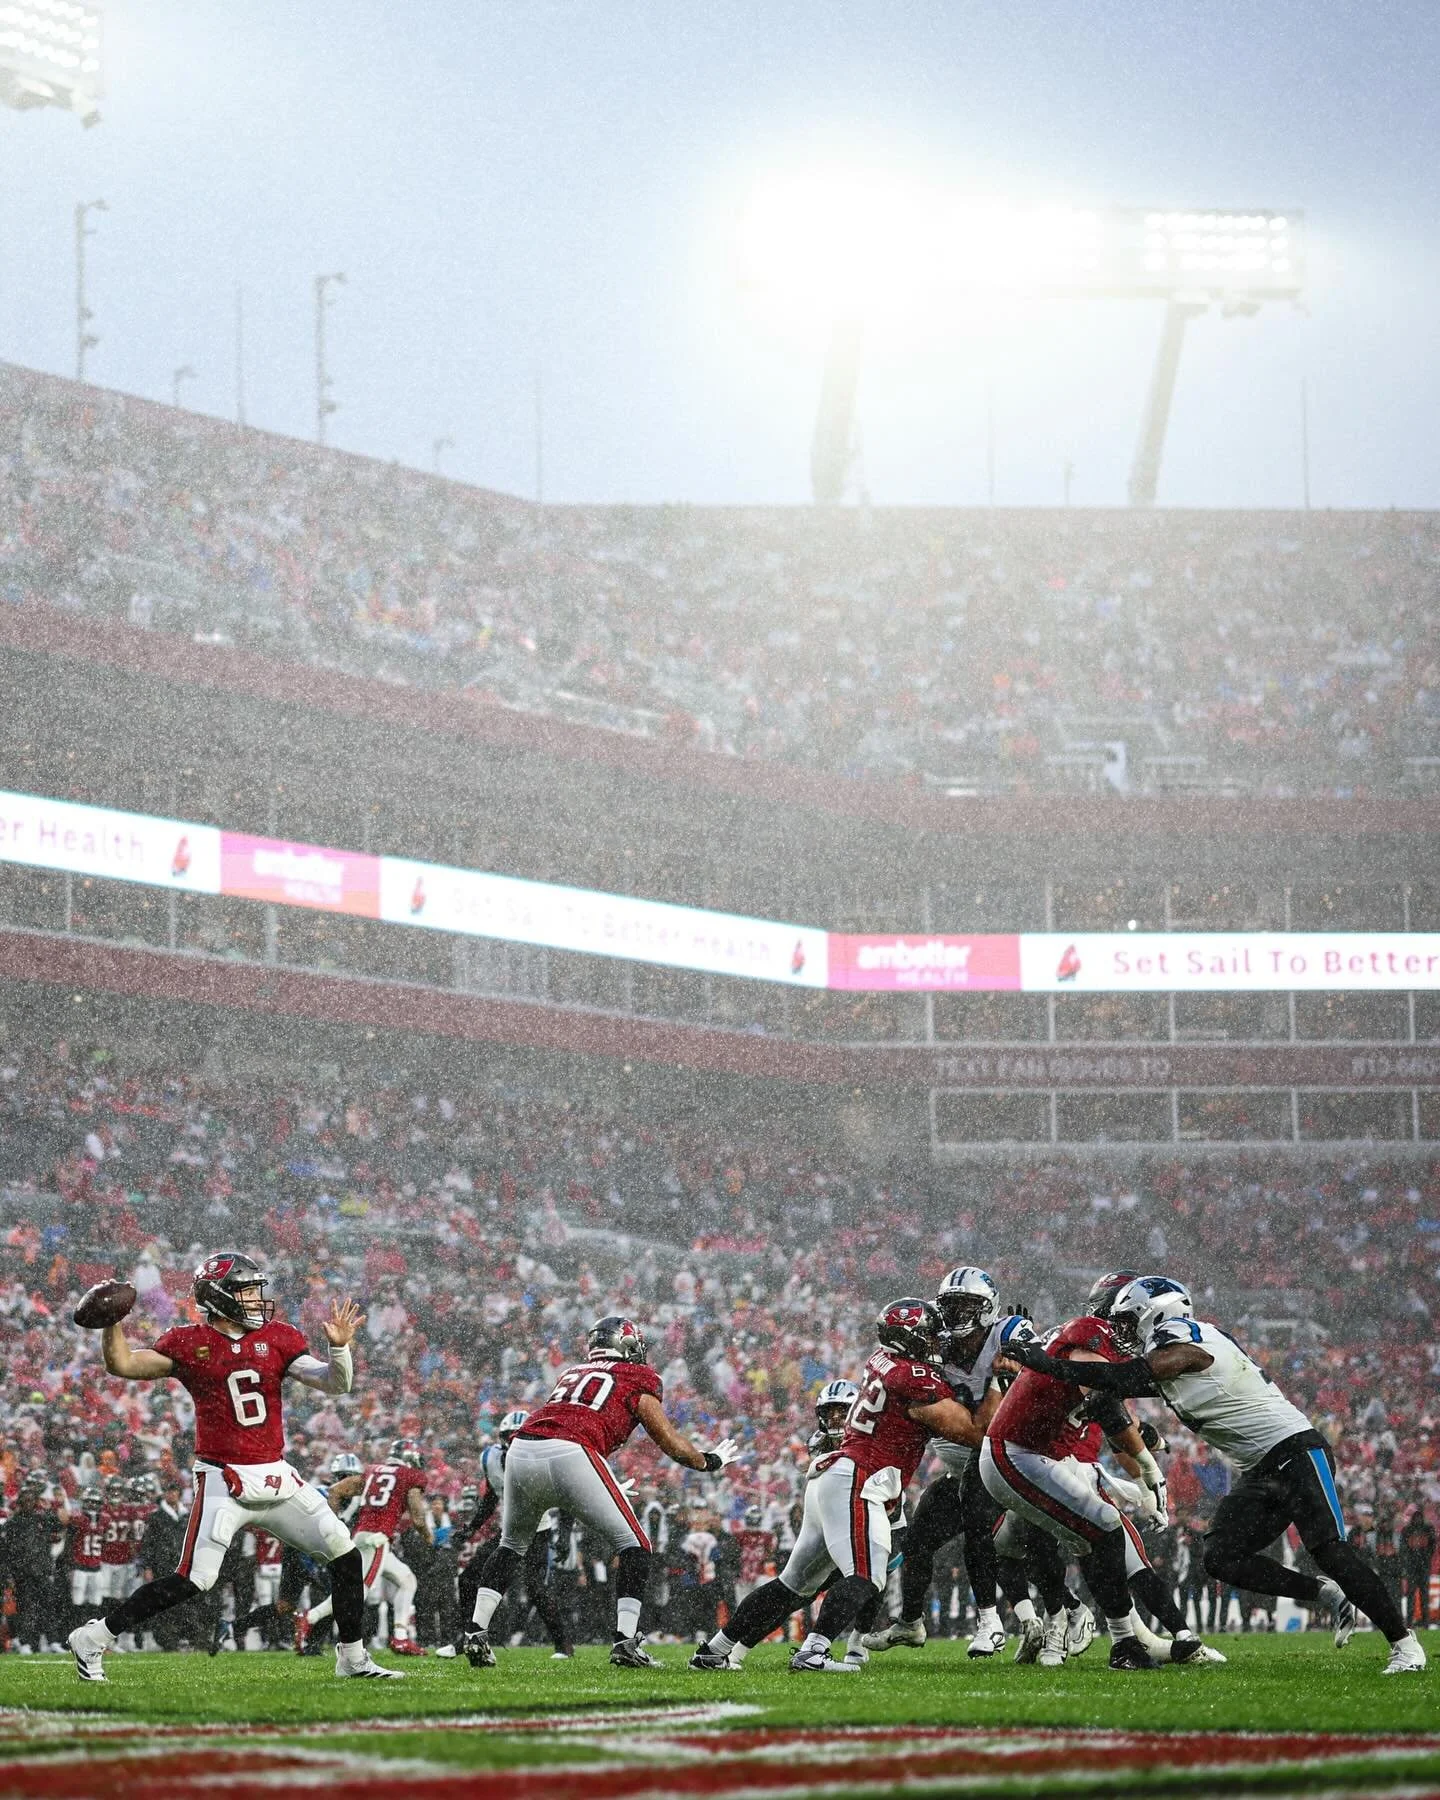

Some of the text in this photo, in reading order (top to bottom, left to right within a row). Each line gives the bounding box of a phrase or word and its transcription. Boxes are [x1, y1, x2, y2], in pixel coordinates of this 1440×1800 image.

[39, 817, 145, 863] Health
[1114, 947, 1439, 976] Set Sail To Better
[227, 1369, 267, 1426] 6
[360, 1473, 397, 1506] 13
